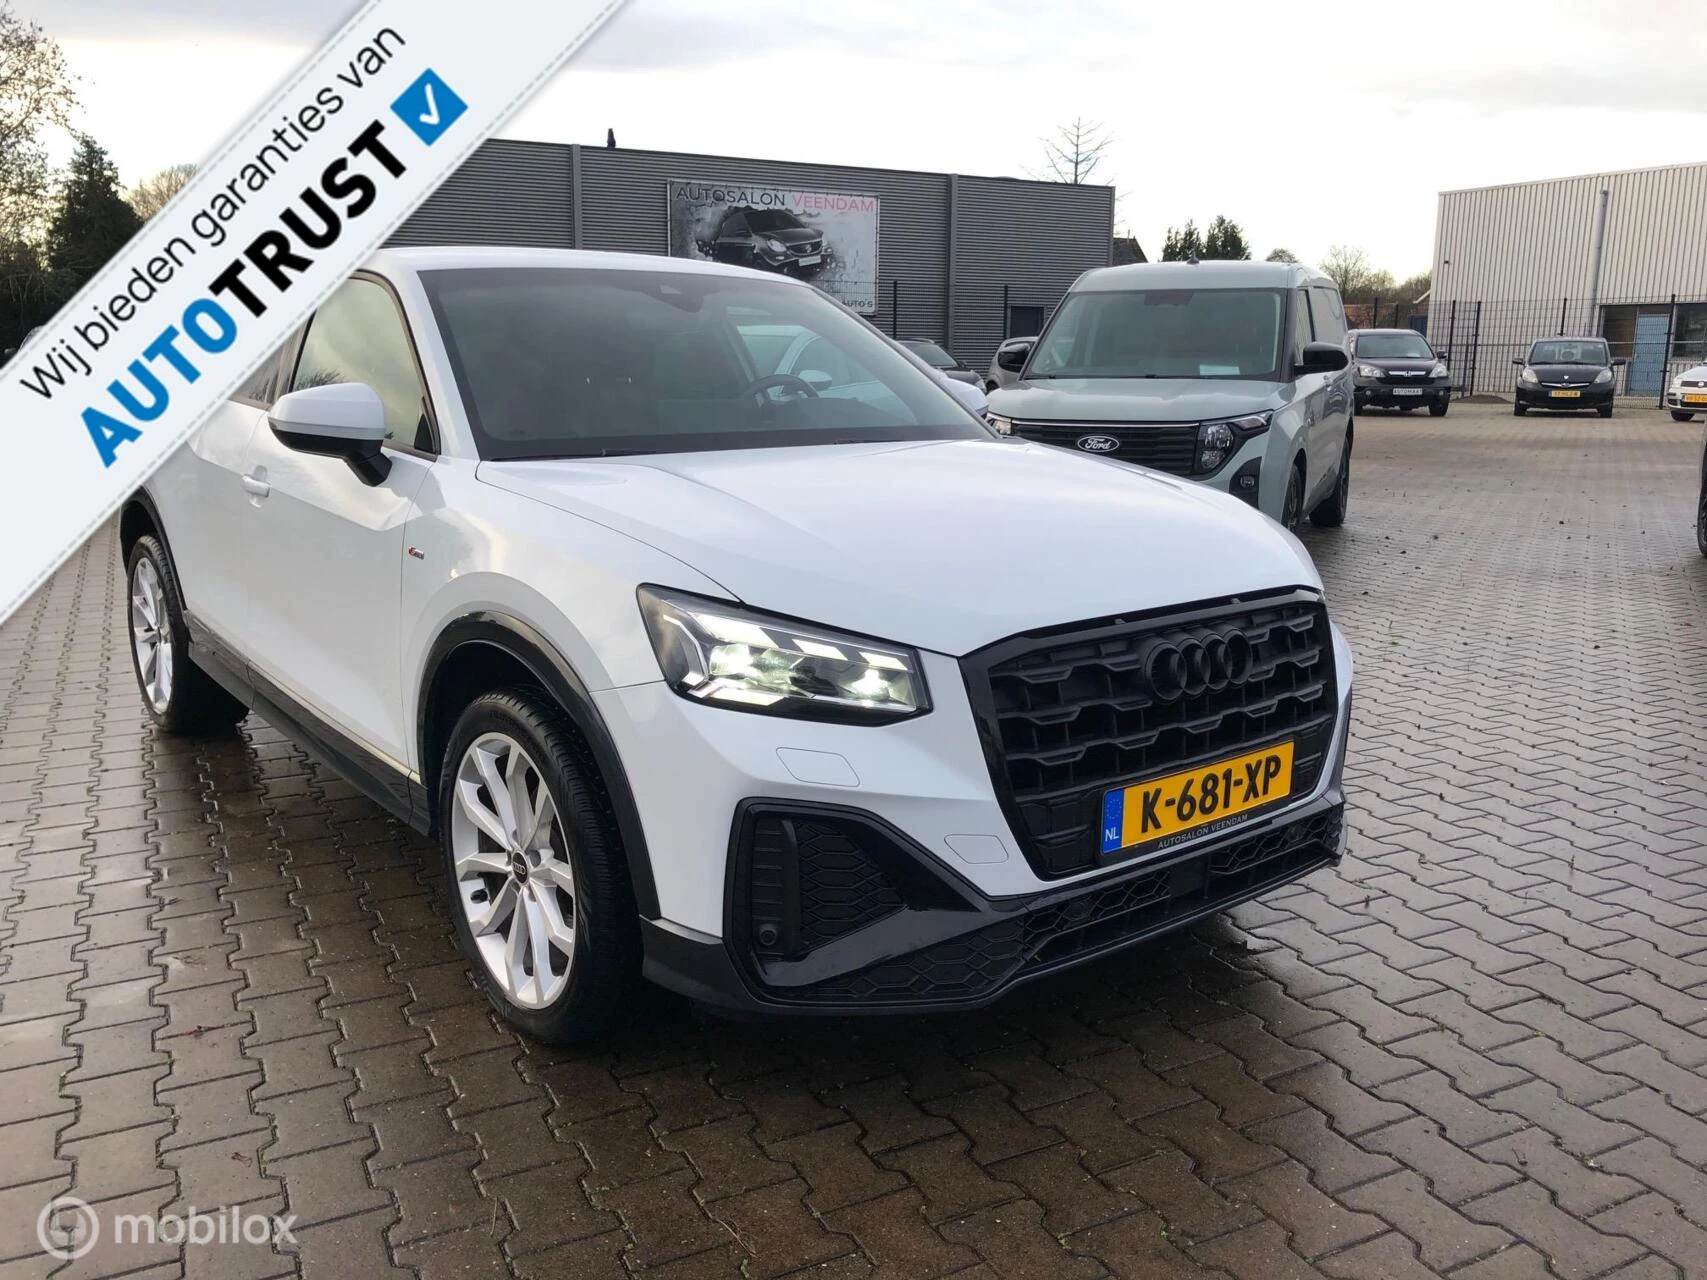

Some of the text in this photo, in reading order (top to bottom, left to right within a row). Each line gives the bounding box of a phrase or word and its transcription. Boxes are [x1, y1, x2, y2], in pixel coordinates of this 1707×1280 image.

[676, 187, 874, 212] AUTOSALON VEENDAM
[1084, 437, 1112, 450] Ford
[1141, 755, 1281, 833] K-681-XP
[1105, 827, 1119, 842] NL
[1158, 814, 1248, 849] AUTOSALON VEENDAM
